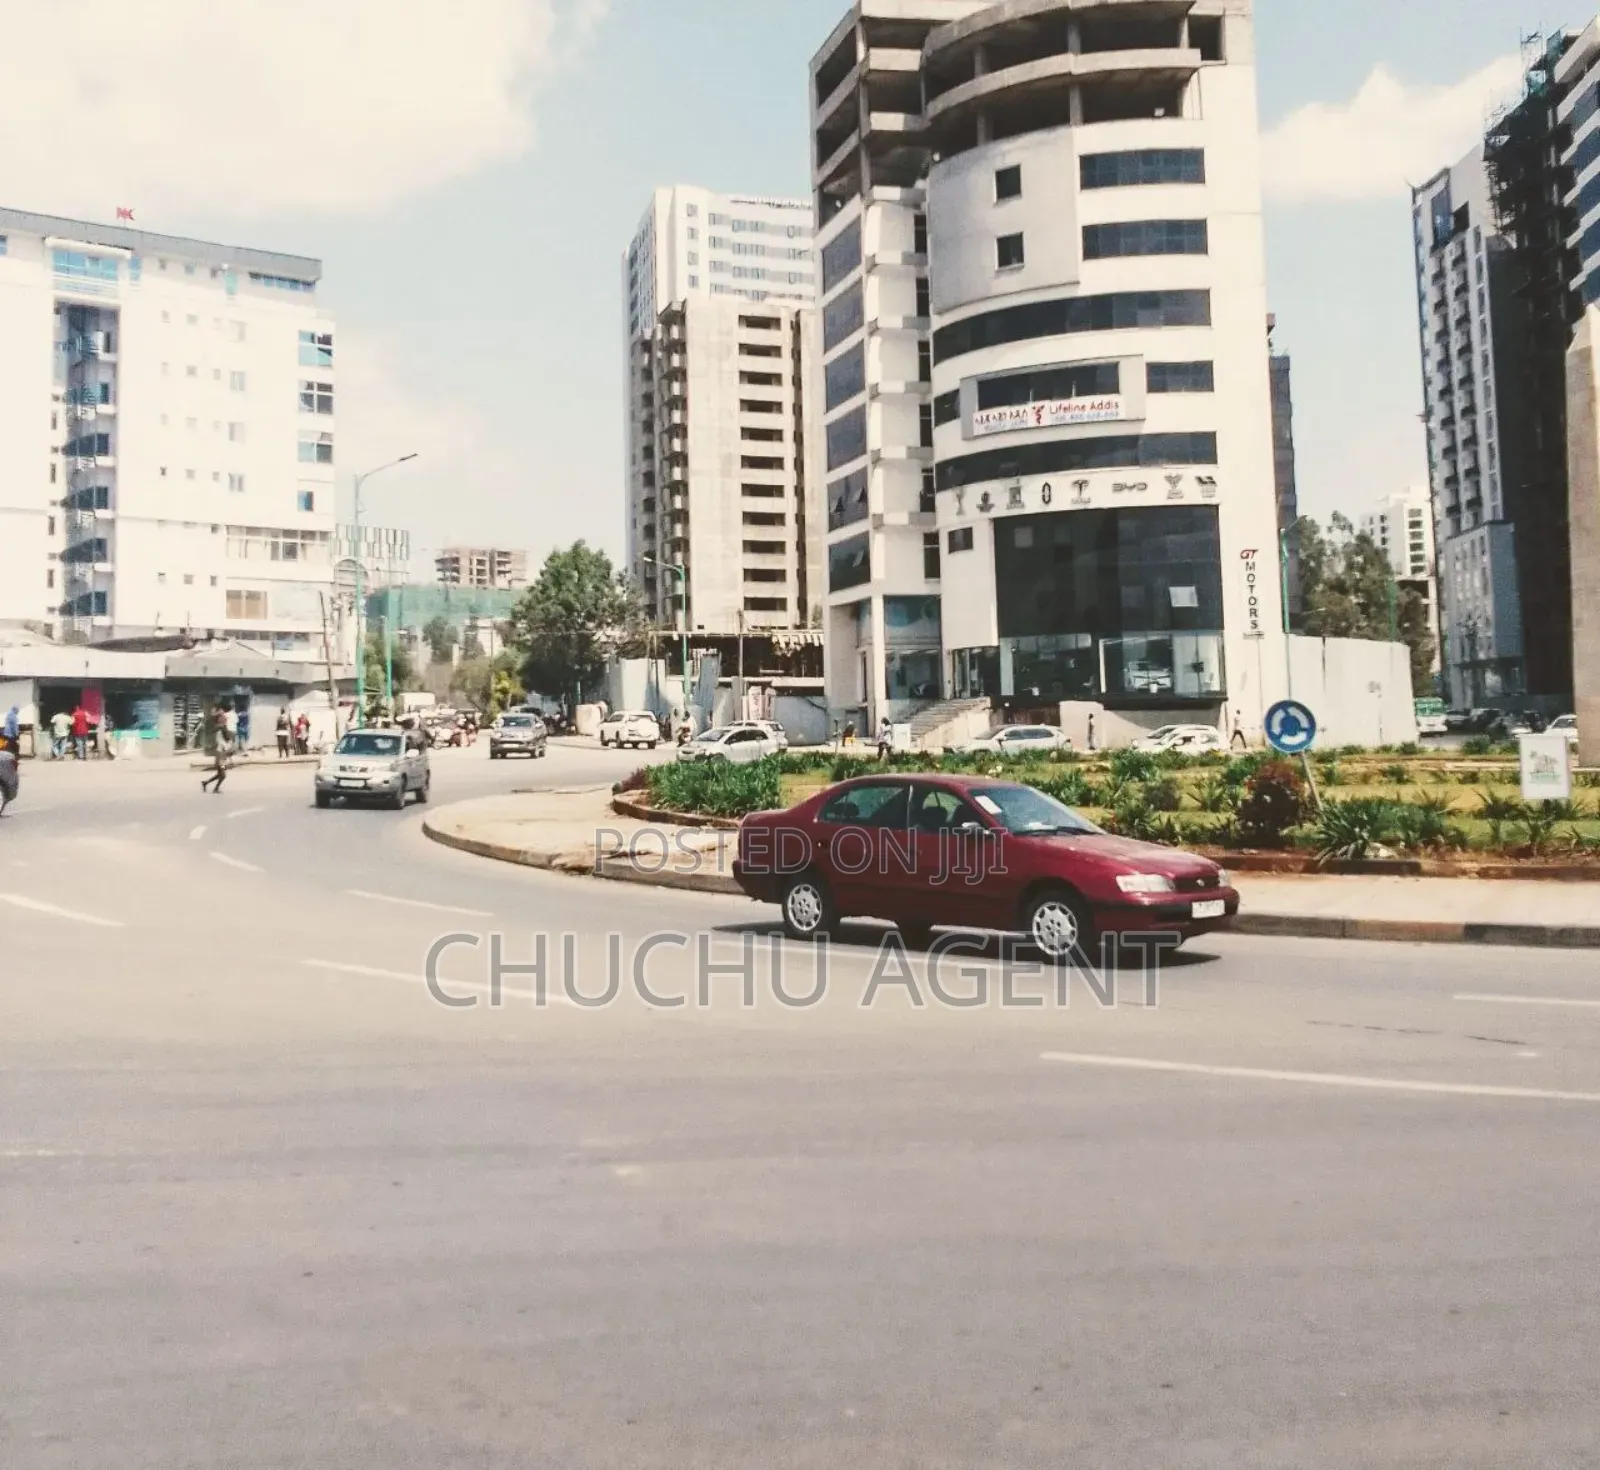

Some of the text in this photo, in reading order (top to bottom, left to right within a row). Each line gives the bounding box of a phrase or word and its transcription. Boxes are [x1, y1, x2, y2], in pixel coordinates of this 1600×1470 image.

[1049, 400, 1119, 414] Lifeline Addis
[1112, 482, 1148, 493] BYD
[1239, 548, 1259, 560] GT
[1245, 561, 1259, 630] MOTORS
